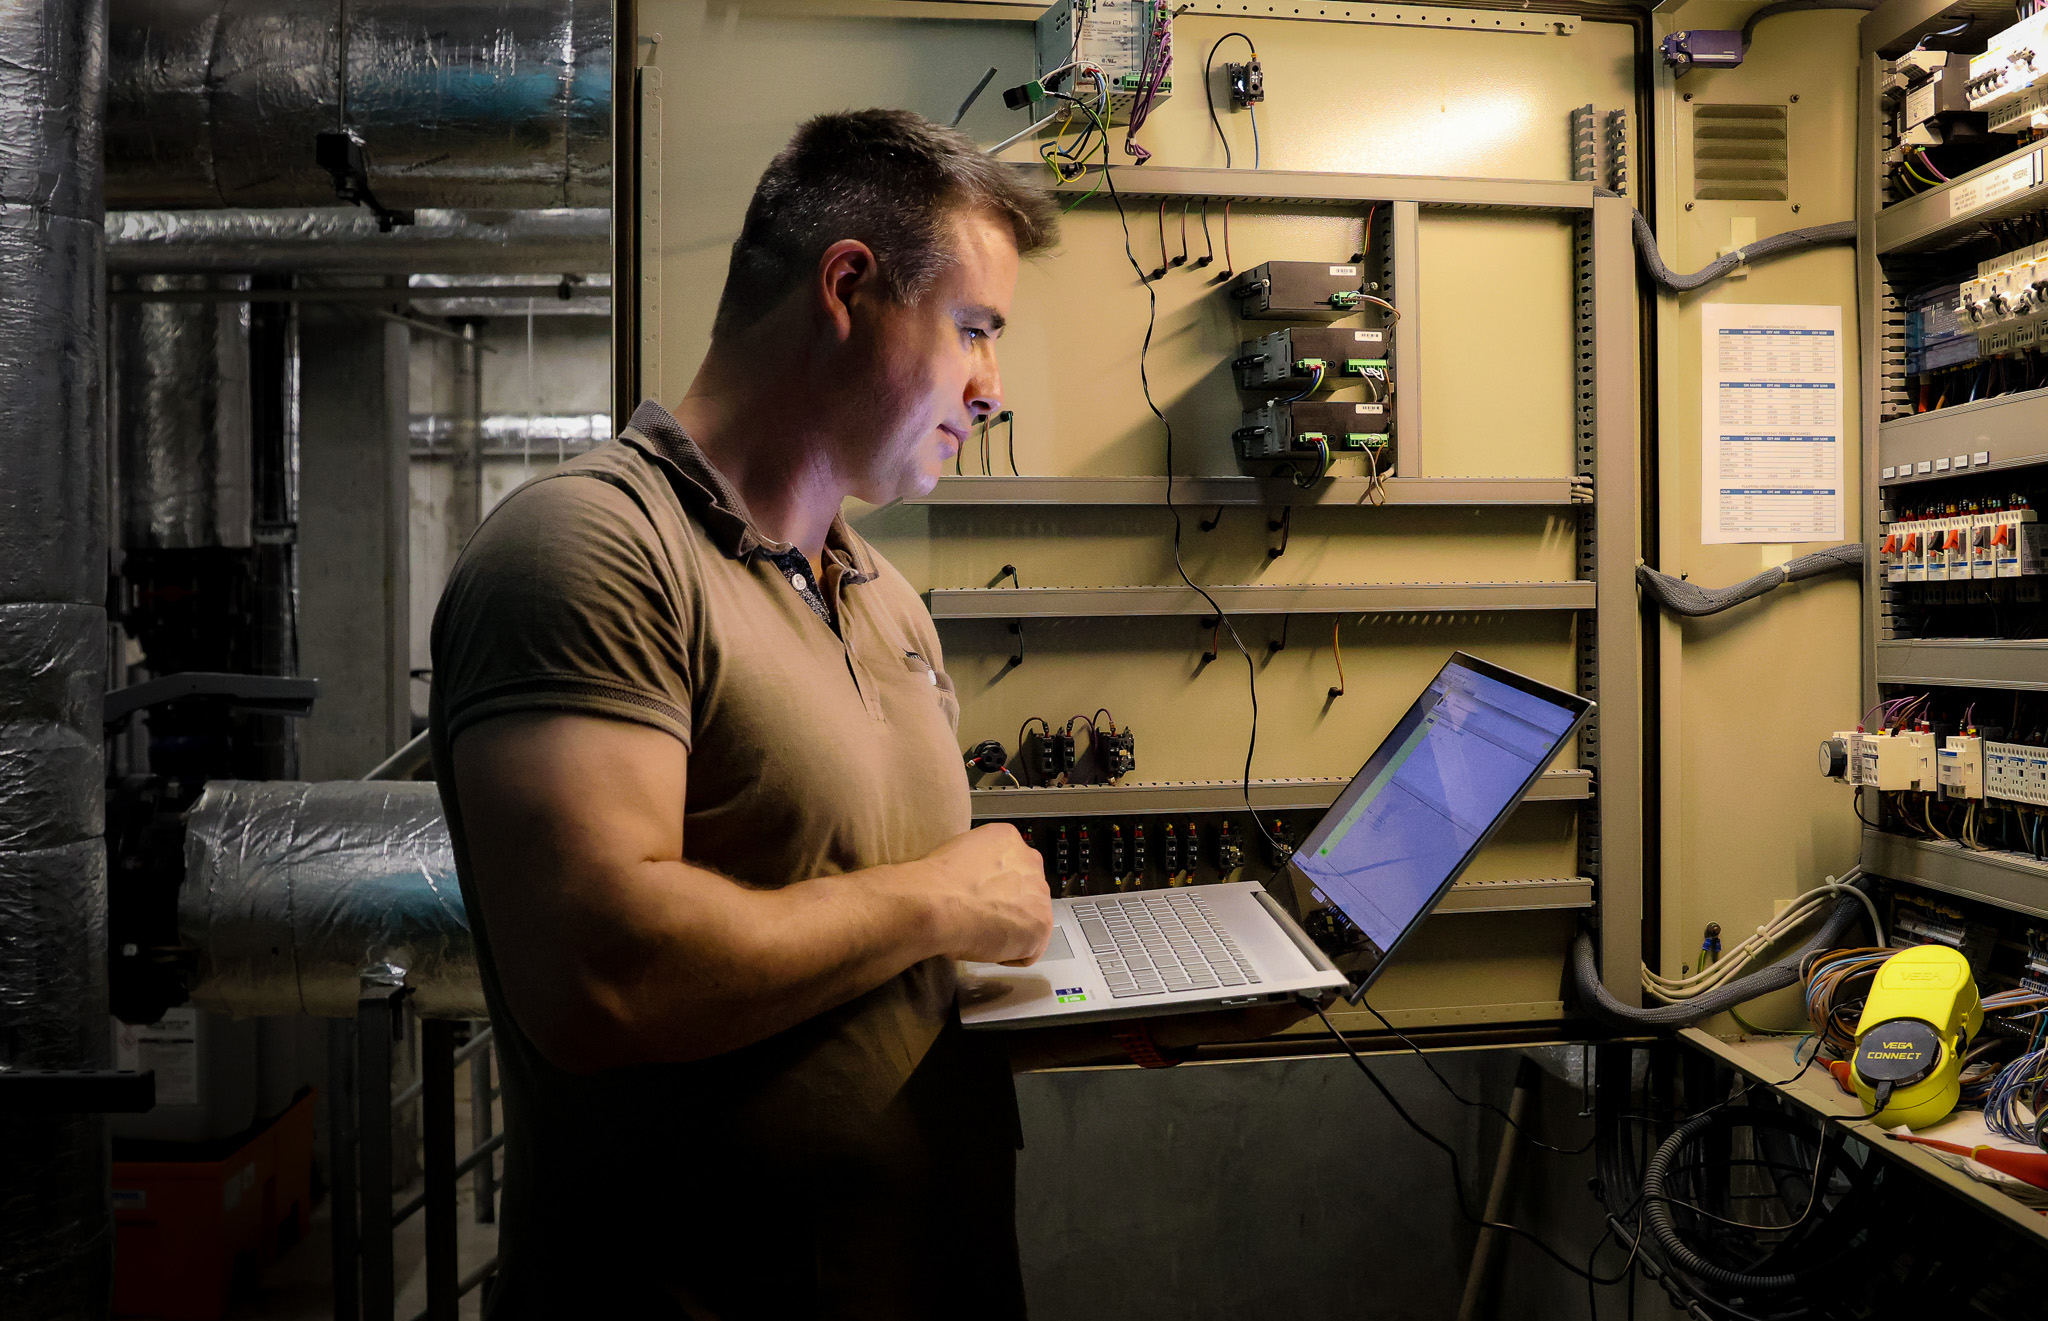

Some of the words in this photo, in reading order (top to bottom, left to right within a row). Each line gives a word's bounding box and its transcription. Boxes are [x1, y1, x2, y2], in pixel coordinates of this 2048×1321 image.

[1901, 971, 1941, 981] VEGA
[1882, 1042, 1913, 1050] VEGA
[1866, 1052, 1922, 1060] CONNECT
